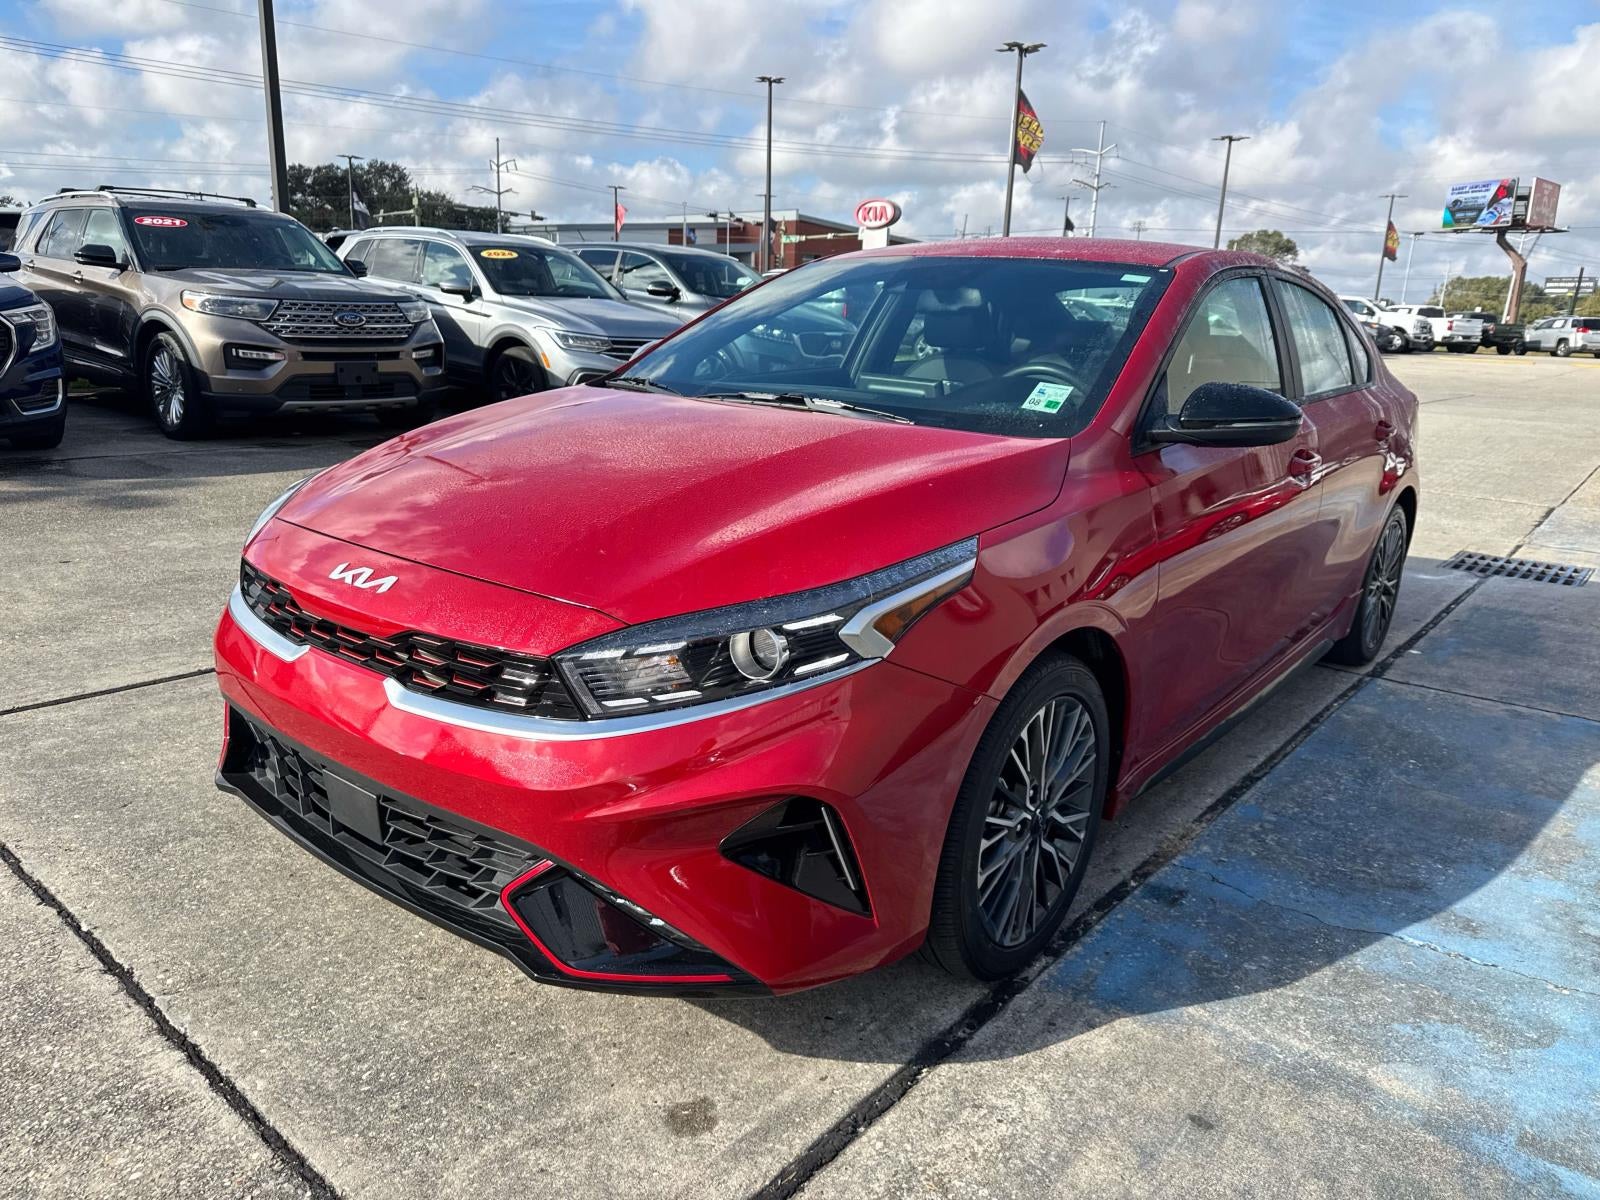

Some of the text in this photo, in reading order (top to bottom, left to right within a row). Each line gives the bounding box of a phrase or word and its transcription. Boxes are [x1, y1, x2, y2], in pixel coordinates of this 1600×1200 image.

[861, 206, 889, 222] KIA
[142, 217, 181, 226] 2021
[1028, 397, 1042, 406] 08
[328, 561, 400, 594] KIA
